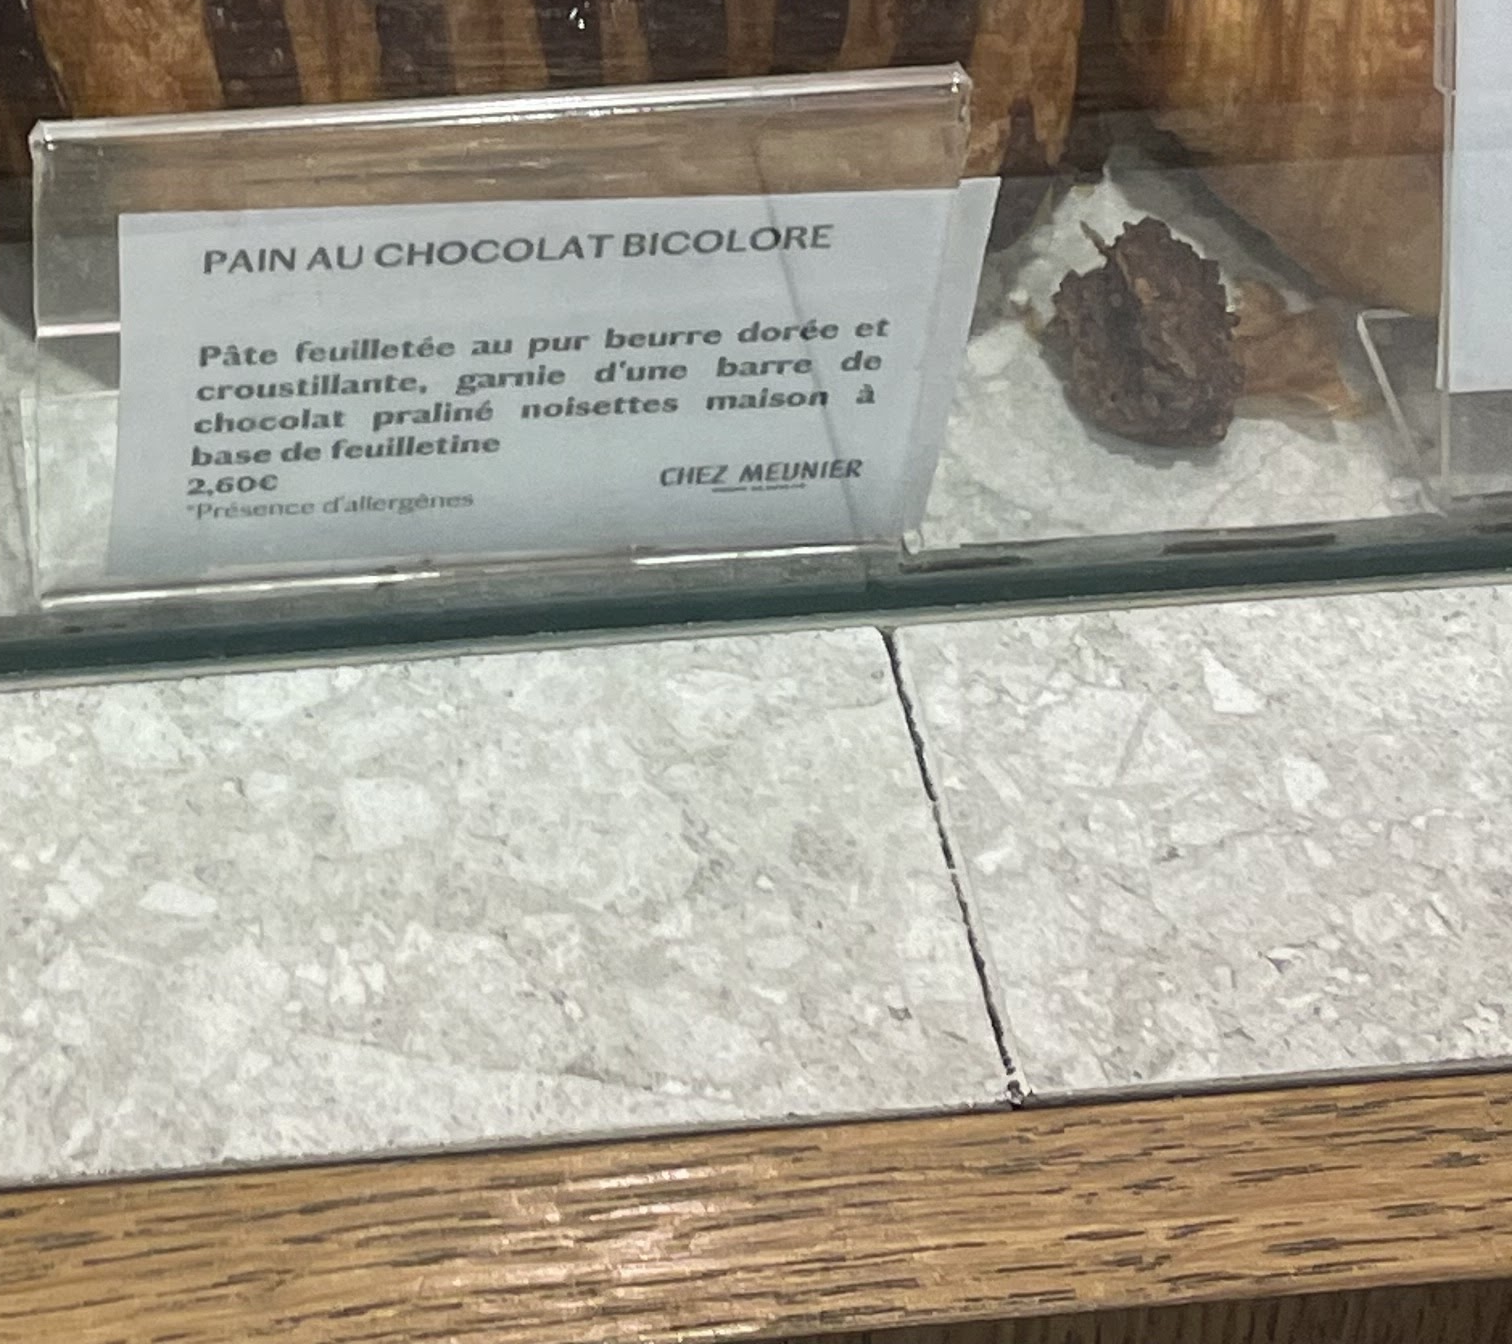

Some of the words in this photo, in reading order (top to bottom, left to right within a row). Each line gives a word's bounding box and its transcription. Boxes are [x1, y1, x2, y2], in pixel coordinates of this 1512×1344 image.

[203, 247, 296, 274] PAIN
[306, 244, 364, 271] AU
[374, 233, 614, 268] CHOCOLAT
[622, 224, 834, 257] BICOLORE
[199, 344, 278, 367] Pâte
[295, 336, 456, 363] feuilletée
[471, 338, 513, 355] au
[528, 334, 589, 359] pur
[604, 327, 722, 350] beurre
[737, 320, 840, 344] dorée
[854, 318, 890, 338] et
[196, 373, 427, 401] croustillante,
[594, 360, 688, 383] d'une
[716, 356, 813, 378] barre
[840, 349, 882, 372] de
[194, 408, 345, 434] chocolat
[372, 400, 494, 432] praliné
[521, 395, 680, 419] noisettes
[705, 386, 829, 411] maison
[855, 383, 875, 405] à
[191, 445, 272, 467] base
[280, 441, 321, 462] de
[331, 435, 500, 460] feuilletine
[659, 464, 729, 487] CHEZ
[738, 458, 864, 483] MEUNIER
